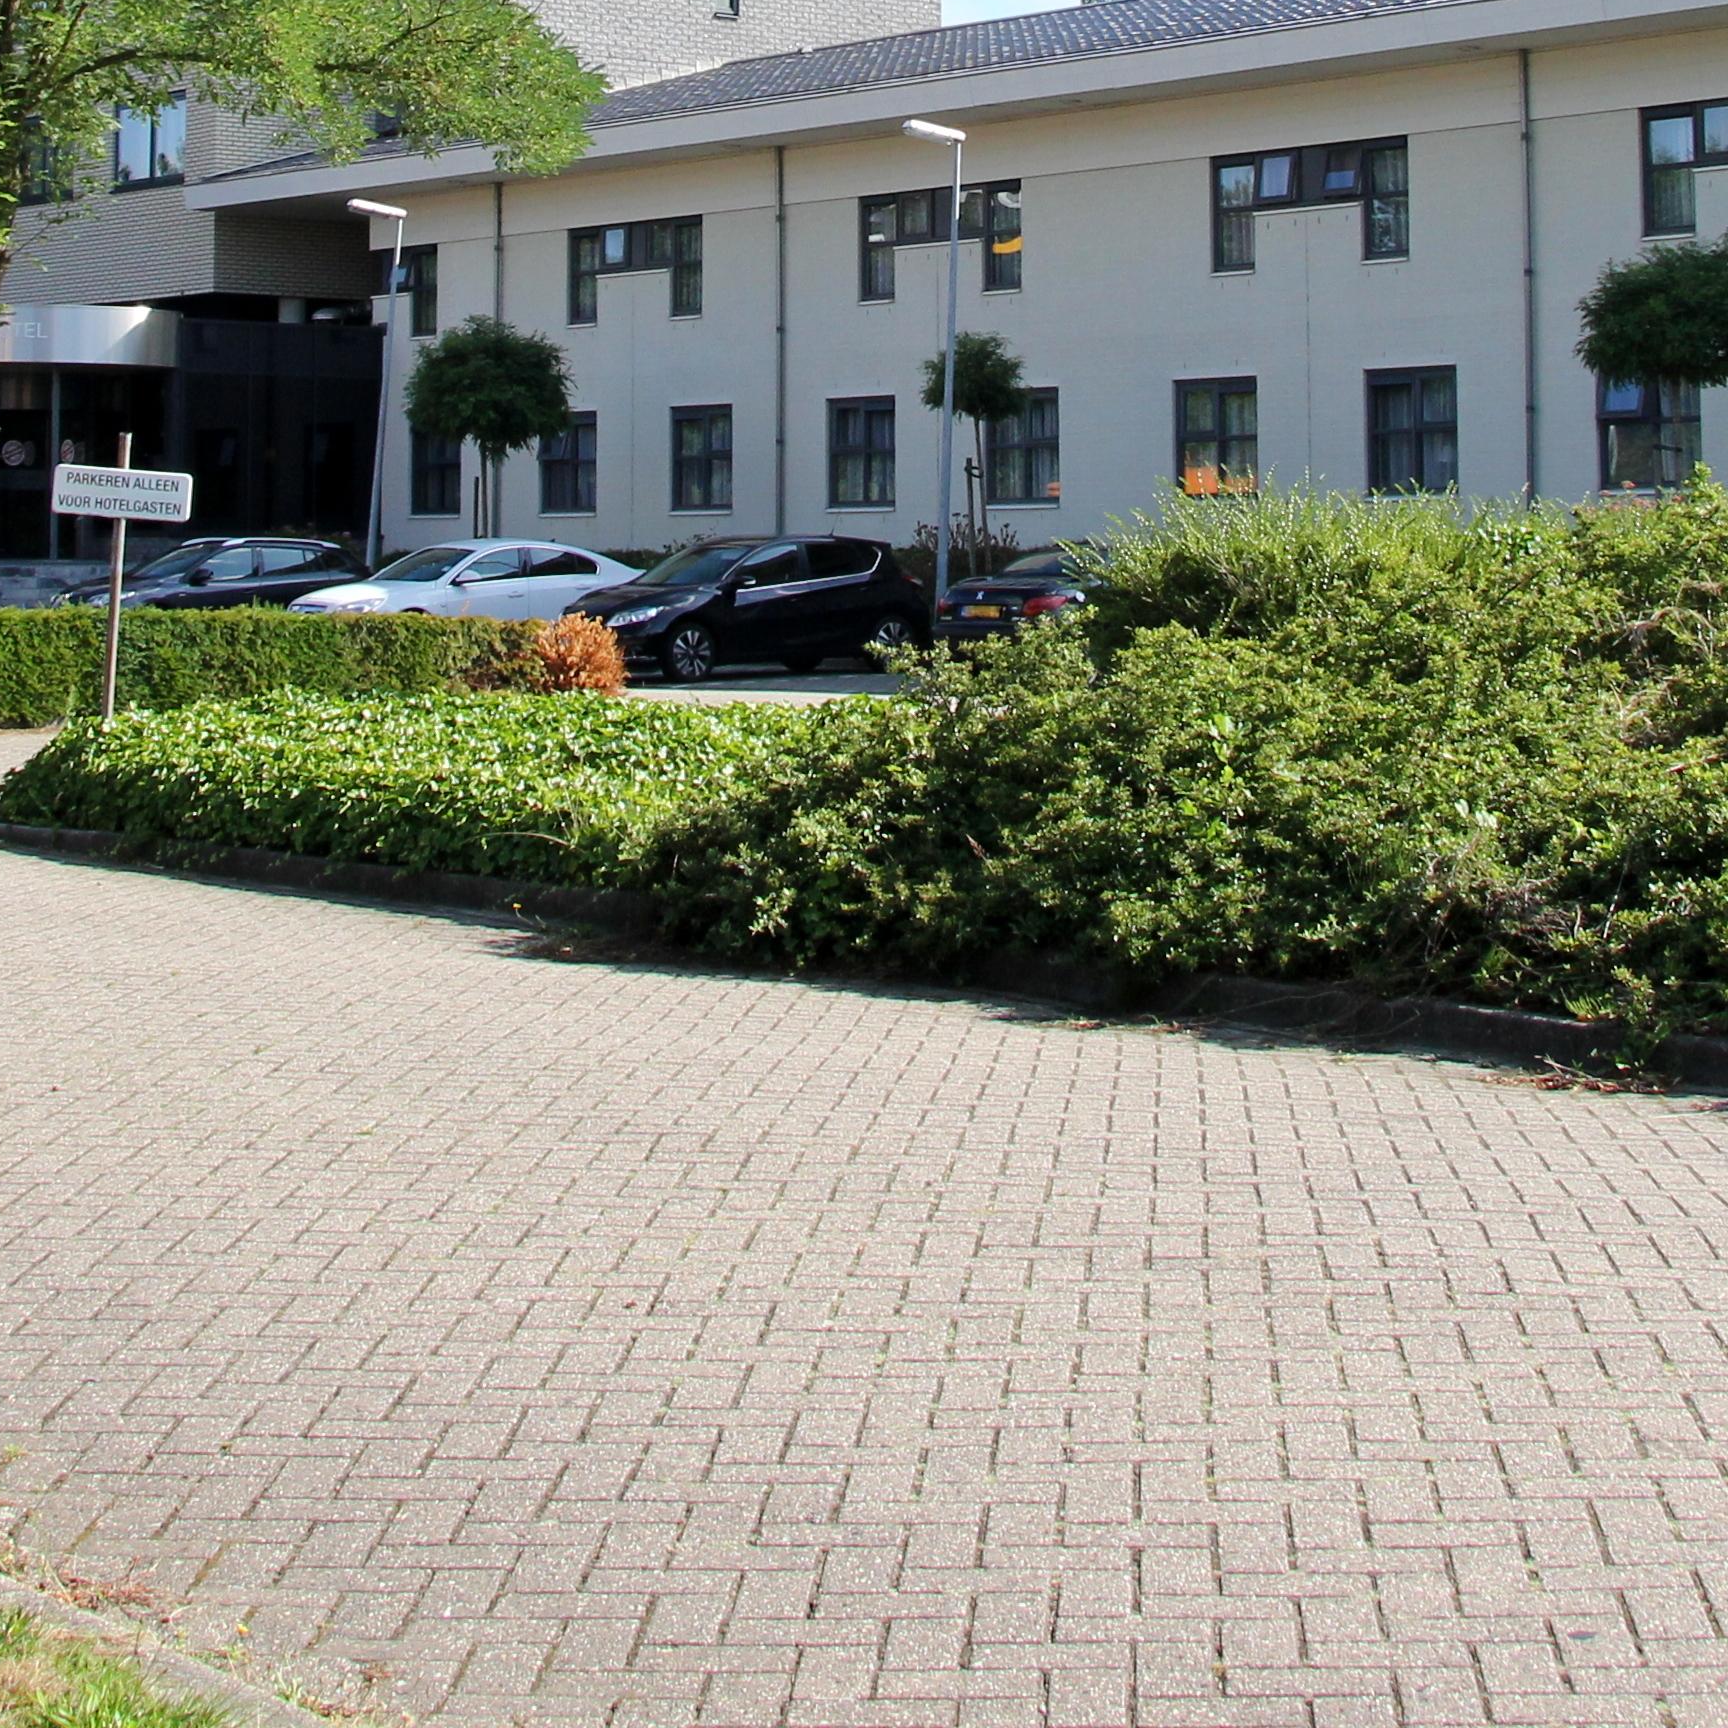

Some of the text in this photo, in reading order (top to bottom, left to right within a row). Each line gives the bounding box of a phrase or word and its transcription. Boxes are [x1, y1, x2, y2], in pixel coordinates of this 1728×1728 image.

[66, 471, 180, 493] PARKEREN ALLEEN
[58, 493, 182, 516] VOOR HOTELGASTEN
